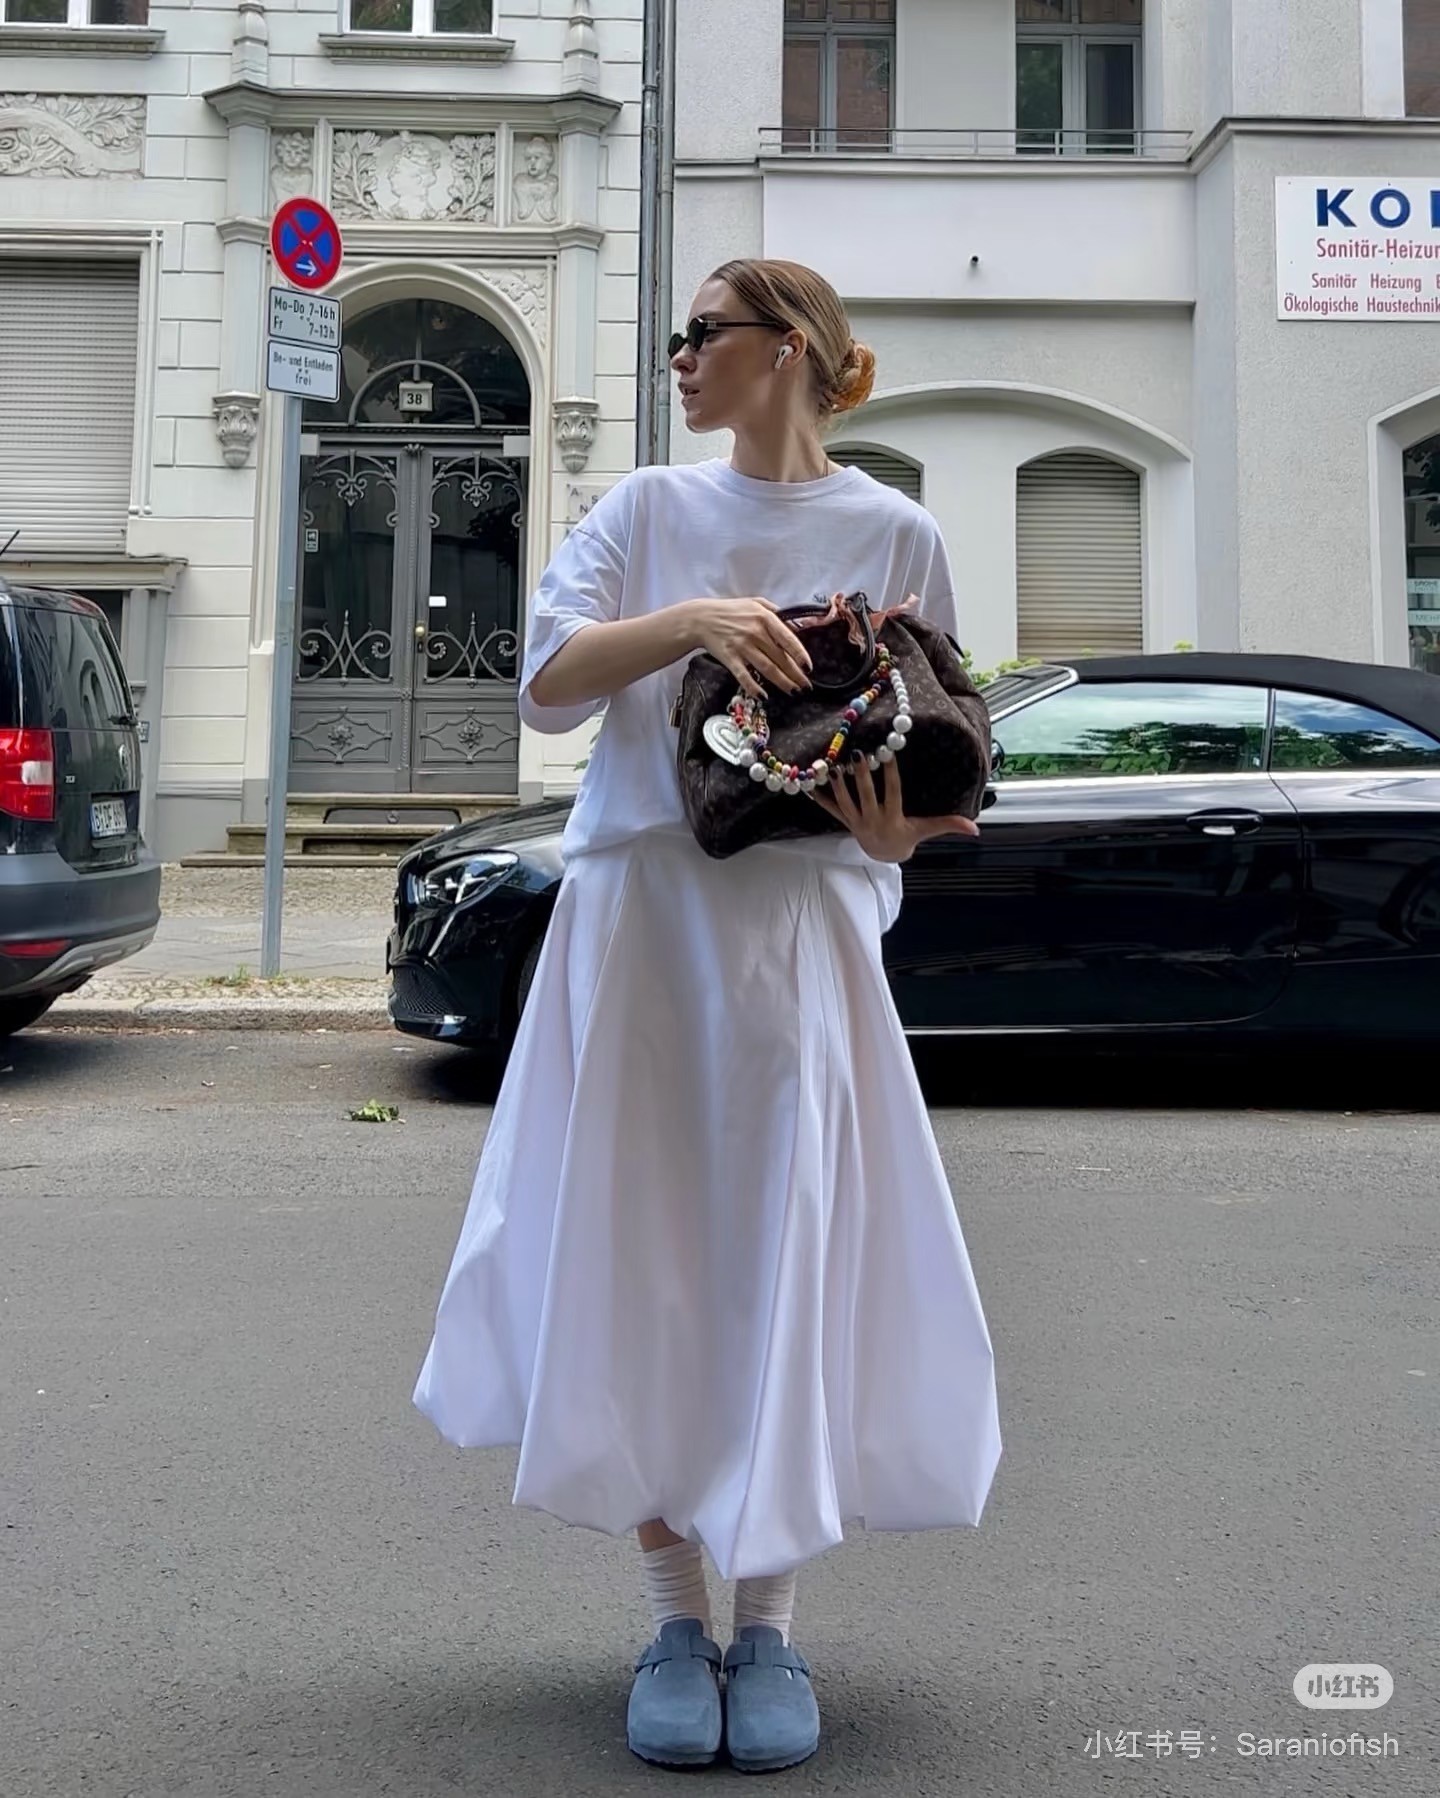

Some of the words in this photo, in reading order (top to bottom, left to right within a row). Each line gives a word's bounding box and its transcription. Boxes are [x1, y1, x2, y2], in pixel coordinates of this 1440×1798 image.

[1312, 273, 1357, 289] Sanitär
[1370, 273, 1422, 293] Heizung
[274, 296, 304, 314] Mo-Do
[1284, 292, 1359, 316] Ökologische
[274, 315, 283, 330] Fr
[289, 355, 302, 367] und
[304, 356, 334, 372] Entladen
[295, 373, 312, 386] frei
[407, 392, 423, 405] 38
